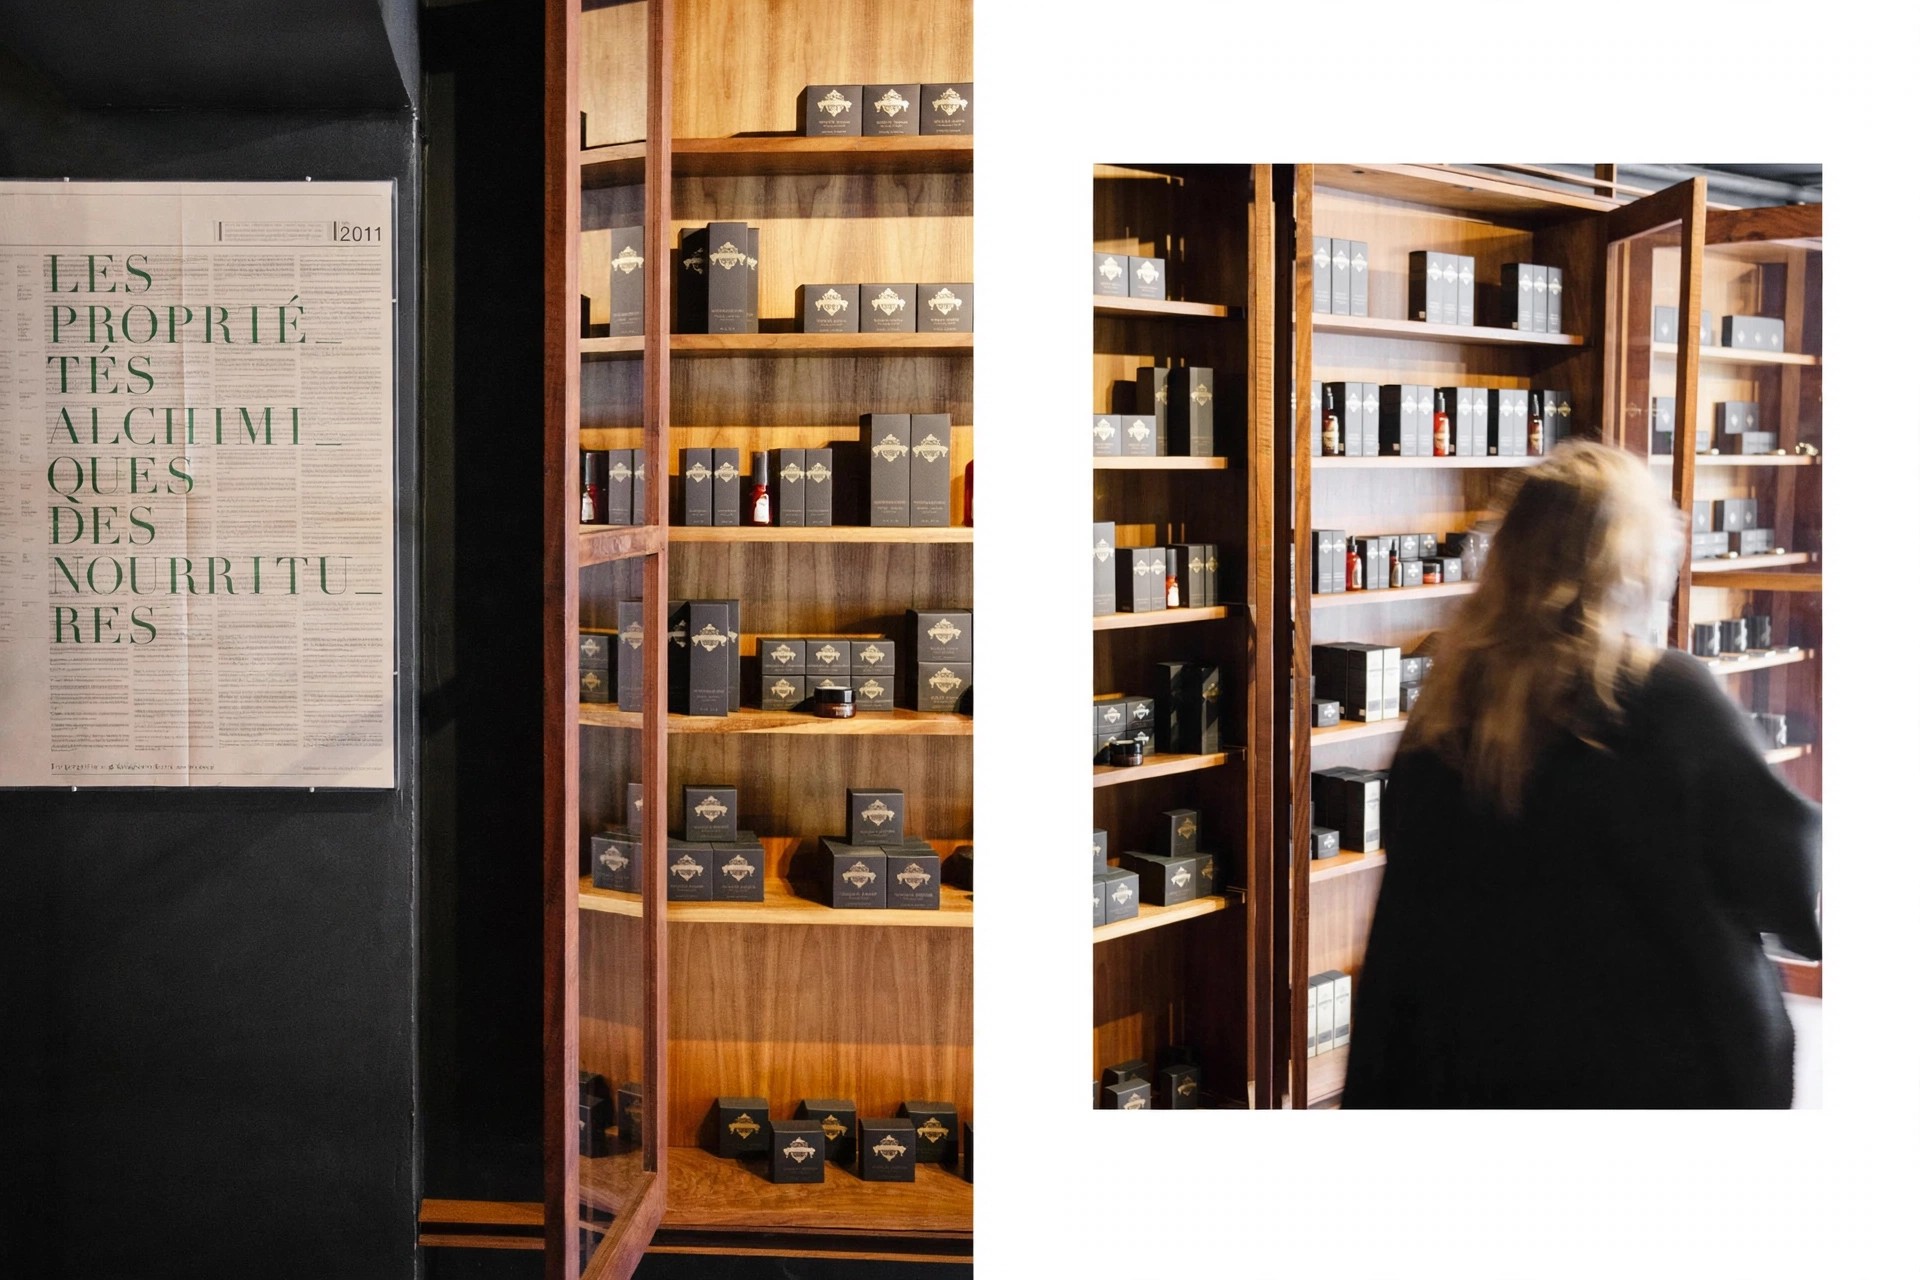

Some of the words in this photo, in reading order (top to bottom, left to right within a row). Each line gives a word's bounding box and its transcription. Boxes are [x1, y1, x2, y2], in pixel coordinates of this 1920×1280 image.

[340, 226, 382, 242] 2011
[46, 253, 153, 294] LES
[47, 344, 155, 395] TÉS
[47, 456, 195, 504] QUES
[48, 506, 156, 545] DES
[51, 605, 158, 645] RES
